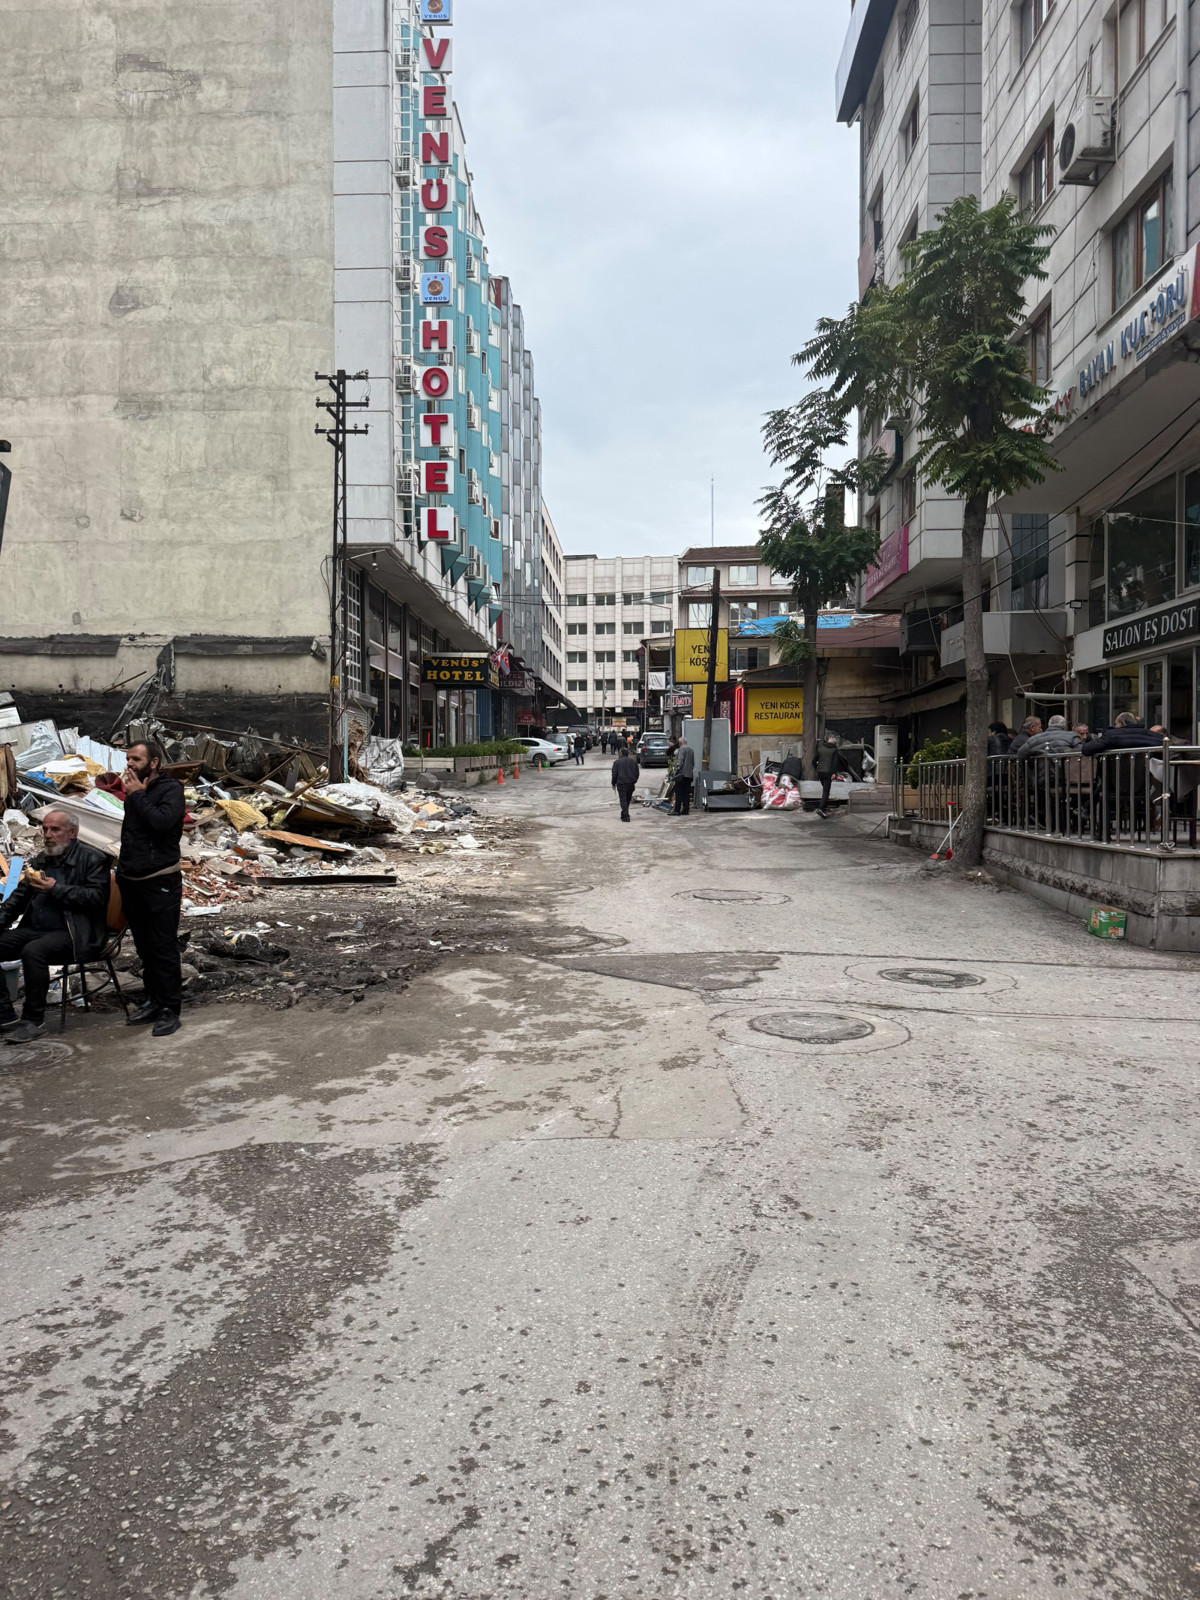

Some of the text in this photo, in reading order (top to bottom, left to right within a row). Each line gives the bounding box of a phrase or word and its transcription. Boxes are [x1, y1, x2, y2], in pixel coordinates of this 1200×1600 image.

[421, 38, 450, 539] VENÜS HOTEL
[1080, 340, 1115, 397] BAYAN
[1105, 606, 1197, 652] SALON EŞ DOST
[691, 644, 710, 654] YEN
[431, 658, 479, 667] VENÜS
[426, 670, 485, 681] HOTEL
[780, 700, 800, 711] KÖŞK
